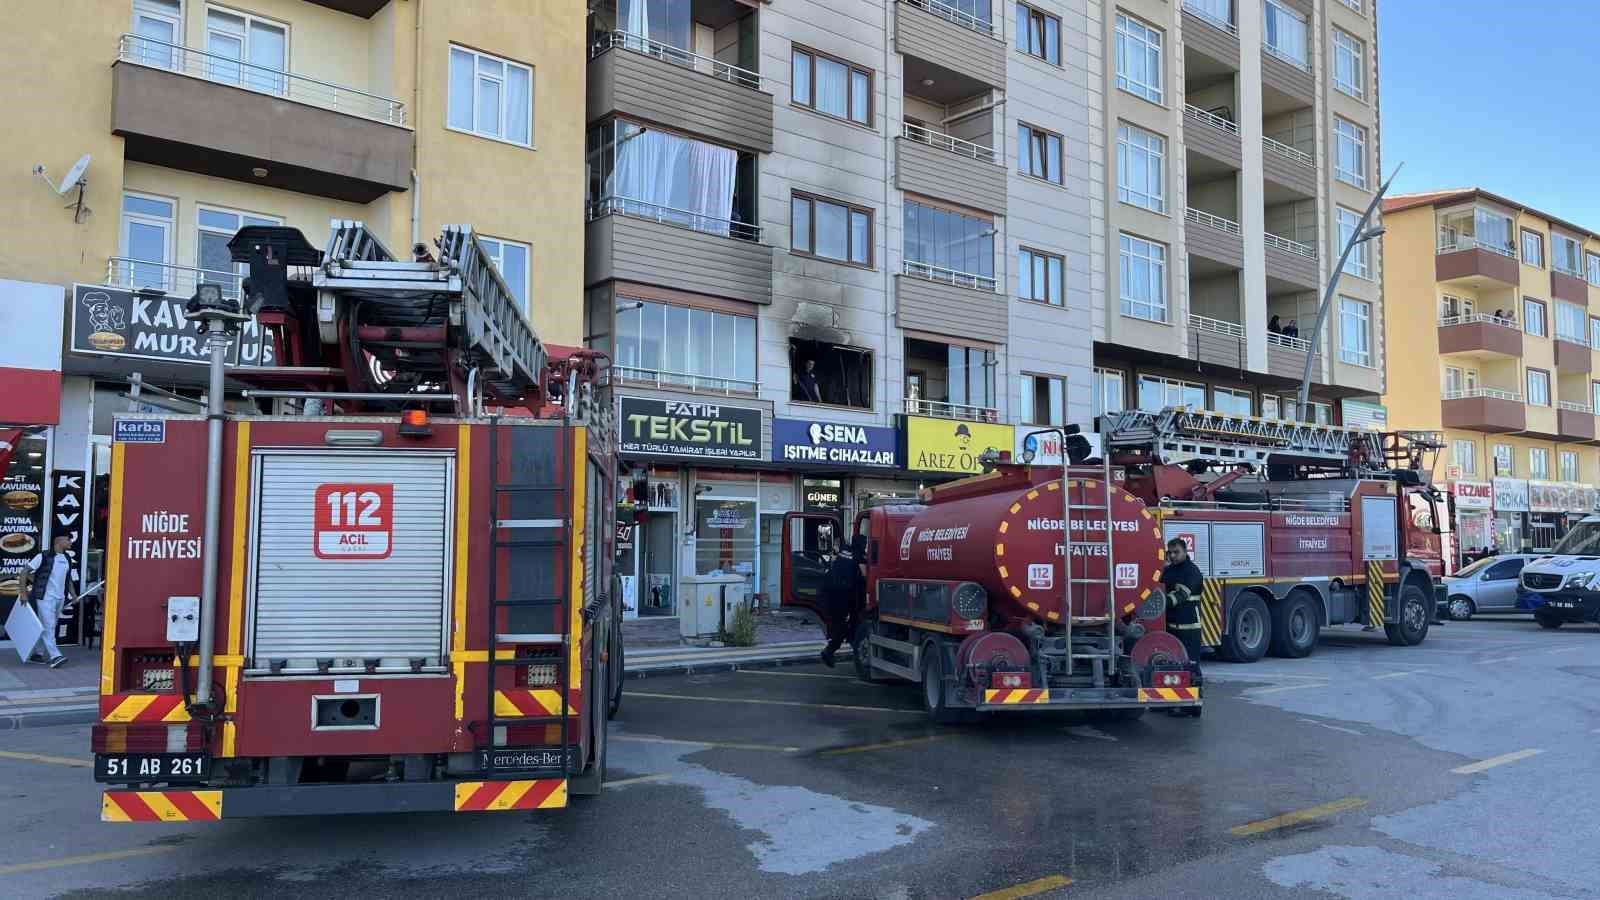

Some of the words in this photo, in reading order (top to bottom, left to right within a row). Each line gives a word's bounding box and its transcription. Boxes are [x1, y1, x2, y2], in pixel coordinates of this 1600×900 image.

[118, 421, 160, 432] karba
[628, 413, 753, 445] TEKSTİL
[824, 424, 868, 444] SENA
[917, 449, 956, 469] AREZ
[807, 491, 838, 502] GÜNER
[328, 491, 382, 526] 112
[142, 511, 189, 533] NİĞDE
[128, 536, 202, 559] İTFAİYESİ
[1033, 567, 1049, 578] 112
[1120, 567, 1135, 578] 112
[107, 758, 128, 775] 51
[140, 758, 161, 775] AB
[171, 757, 202, 775] 261
